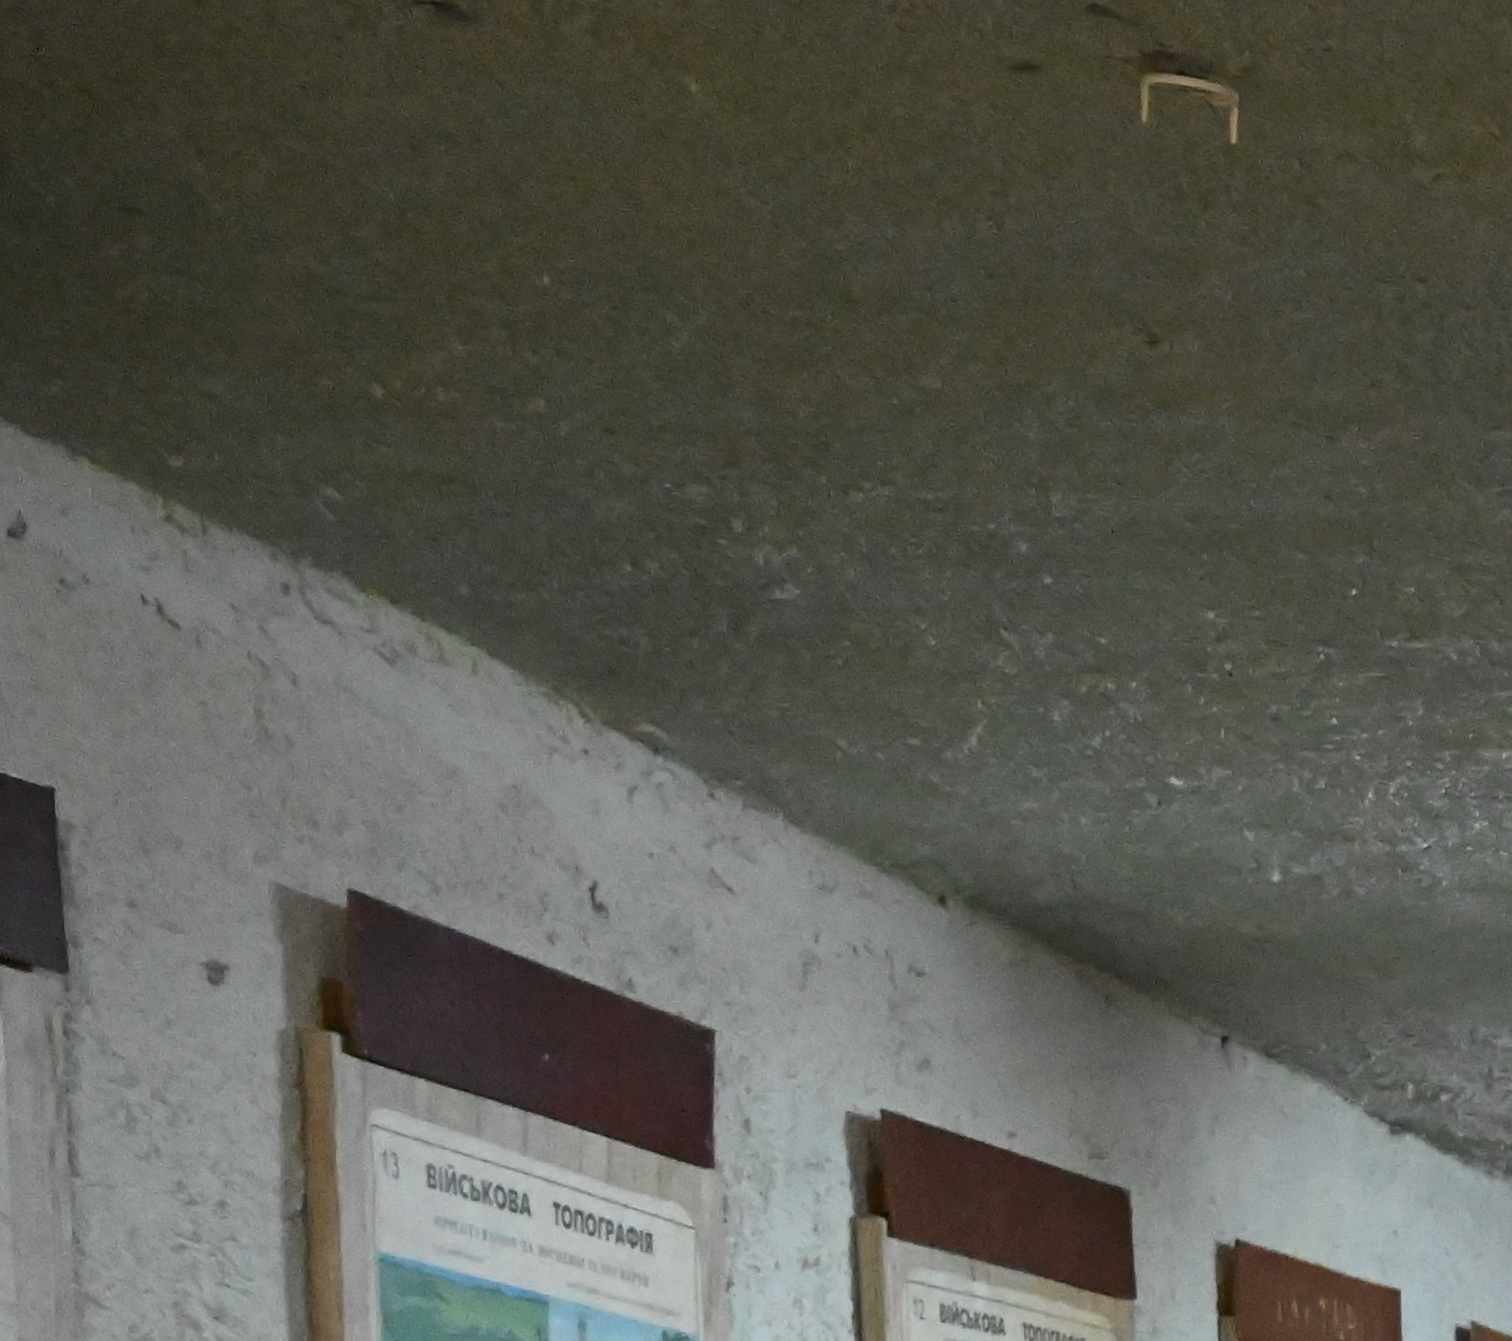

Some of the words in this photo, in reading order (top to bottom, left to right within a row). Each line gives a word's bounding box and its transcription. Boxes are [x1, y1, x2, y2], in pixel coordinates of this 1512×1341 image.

[425, 1162, 533, 1217] ВІЙСЬКОВА
[552, 1201, 655, 1255] ТОПОГРАФІЯ
[938, 1302, 1007, 1336] ВІЙСЬКОВА
